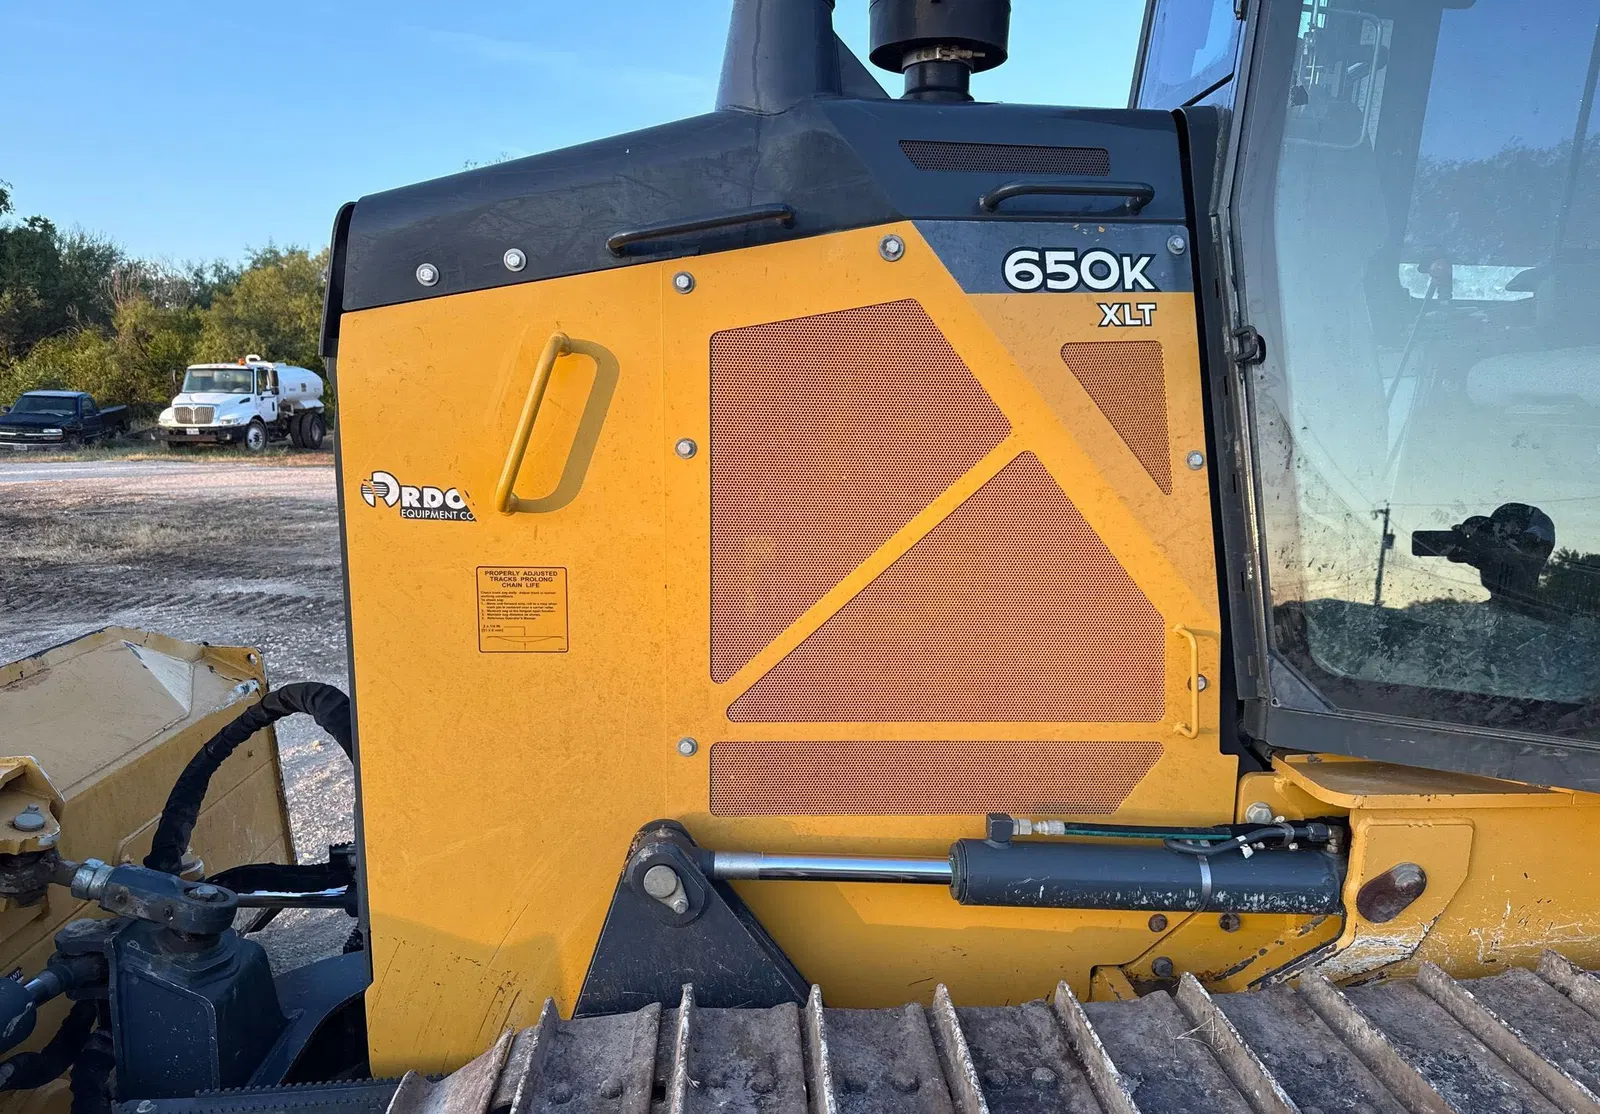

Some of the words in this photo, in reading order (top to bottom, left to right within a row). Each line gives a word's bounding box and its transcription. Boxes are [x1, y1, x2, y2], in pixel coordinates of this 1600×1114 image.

[1003, 247, 1161, 292] 650K
[1097, 303, 1157, 327] XLT
[401, 509, 458, 519] EQUIPMENT
